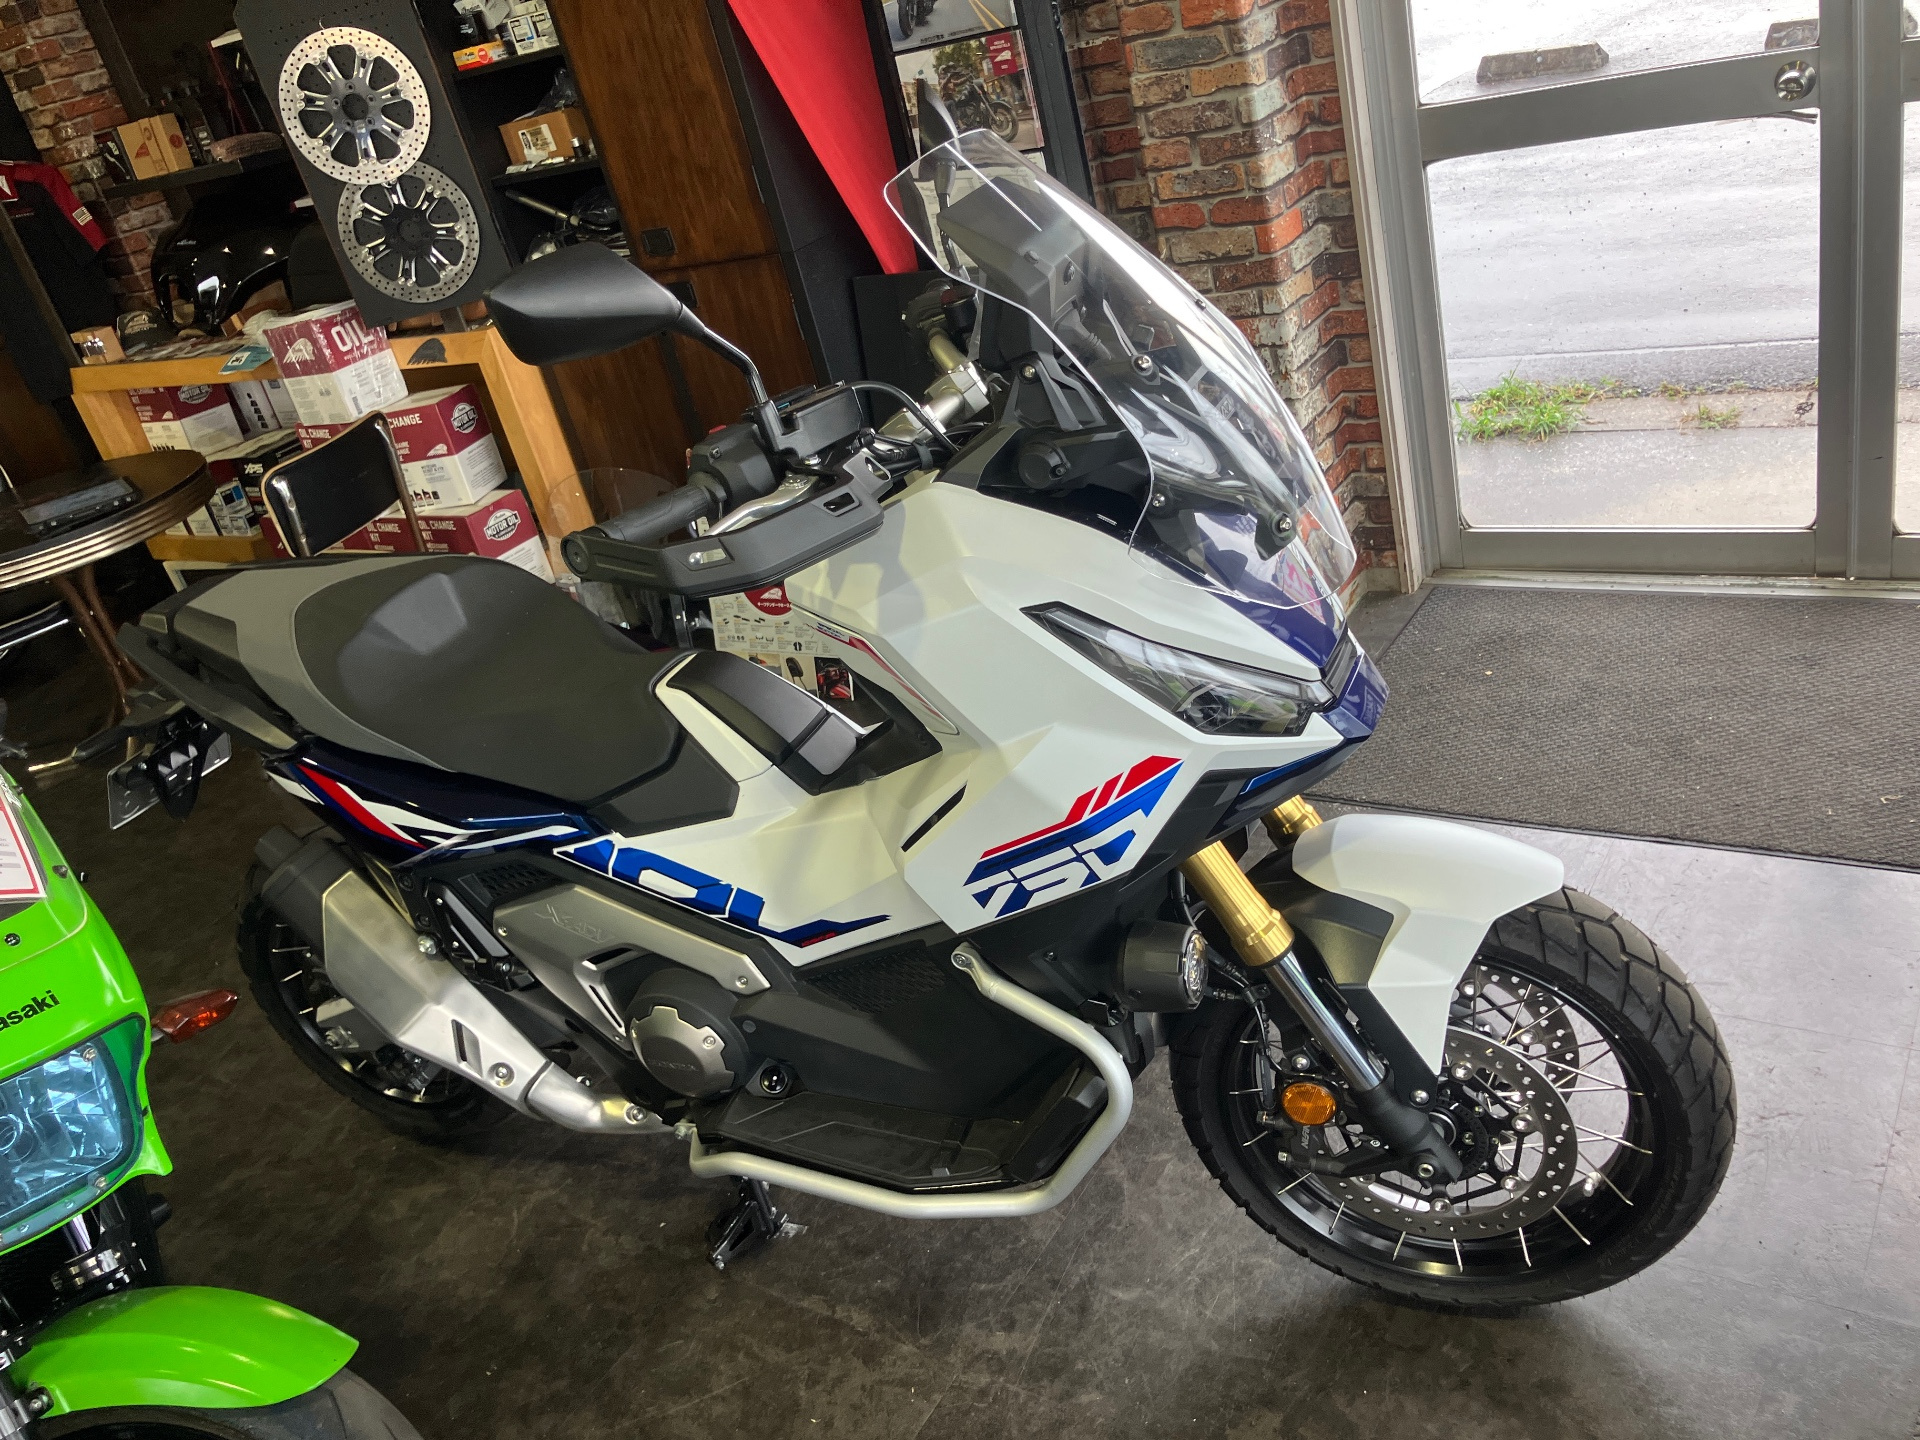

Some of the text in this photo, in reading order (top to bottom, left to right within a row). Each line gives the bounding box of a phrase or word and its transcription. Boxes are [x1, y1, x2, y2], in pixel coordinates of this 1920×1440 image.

[331, 319, 375, 352] OIL
[388, 413, 422, 428] CHANGE
[486, 519, 508, 538] MOTOR
[507, 514, 519, 526] OIL
